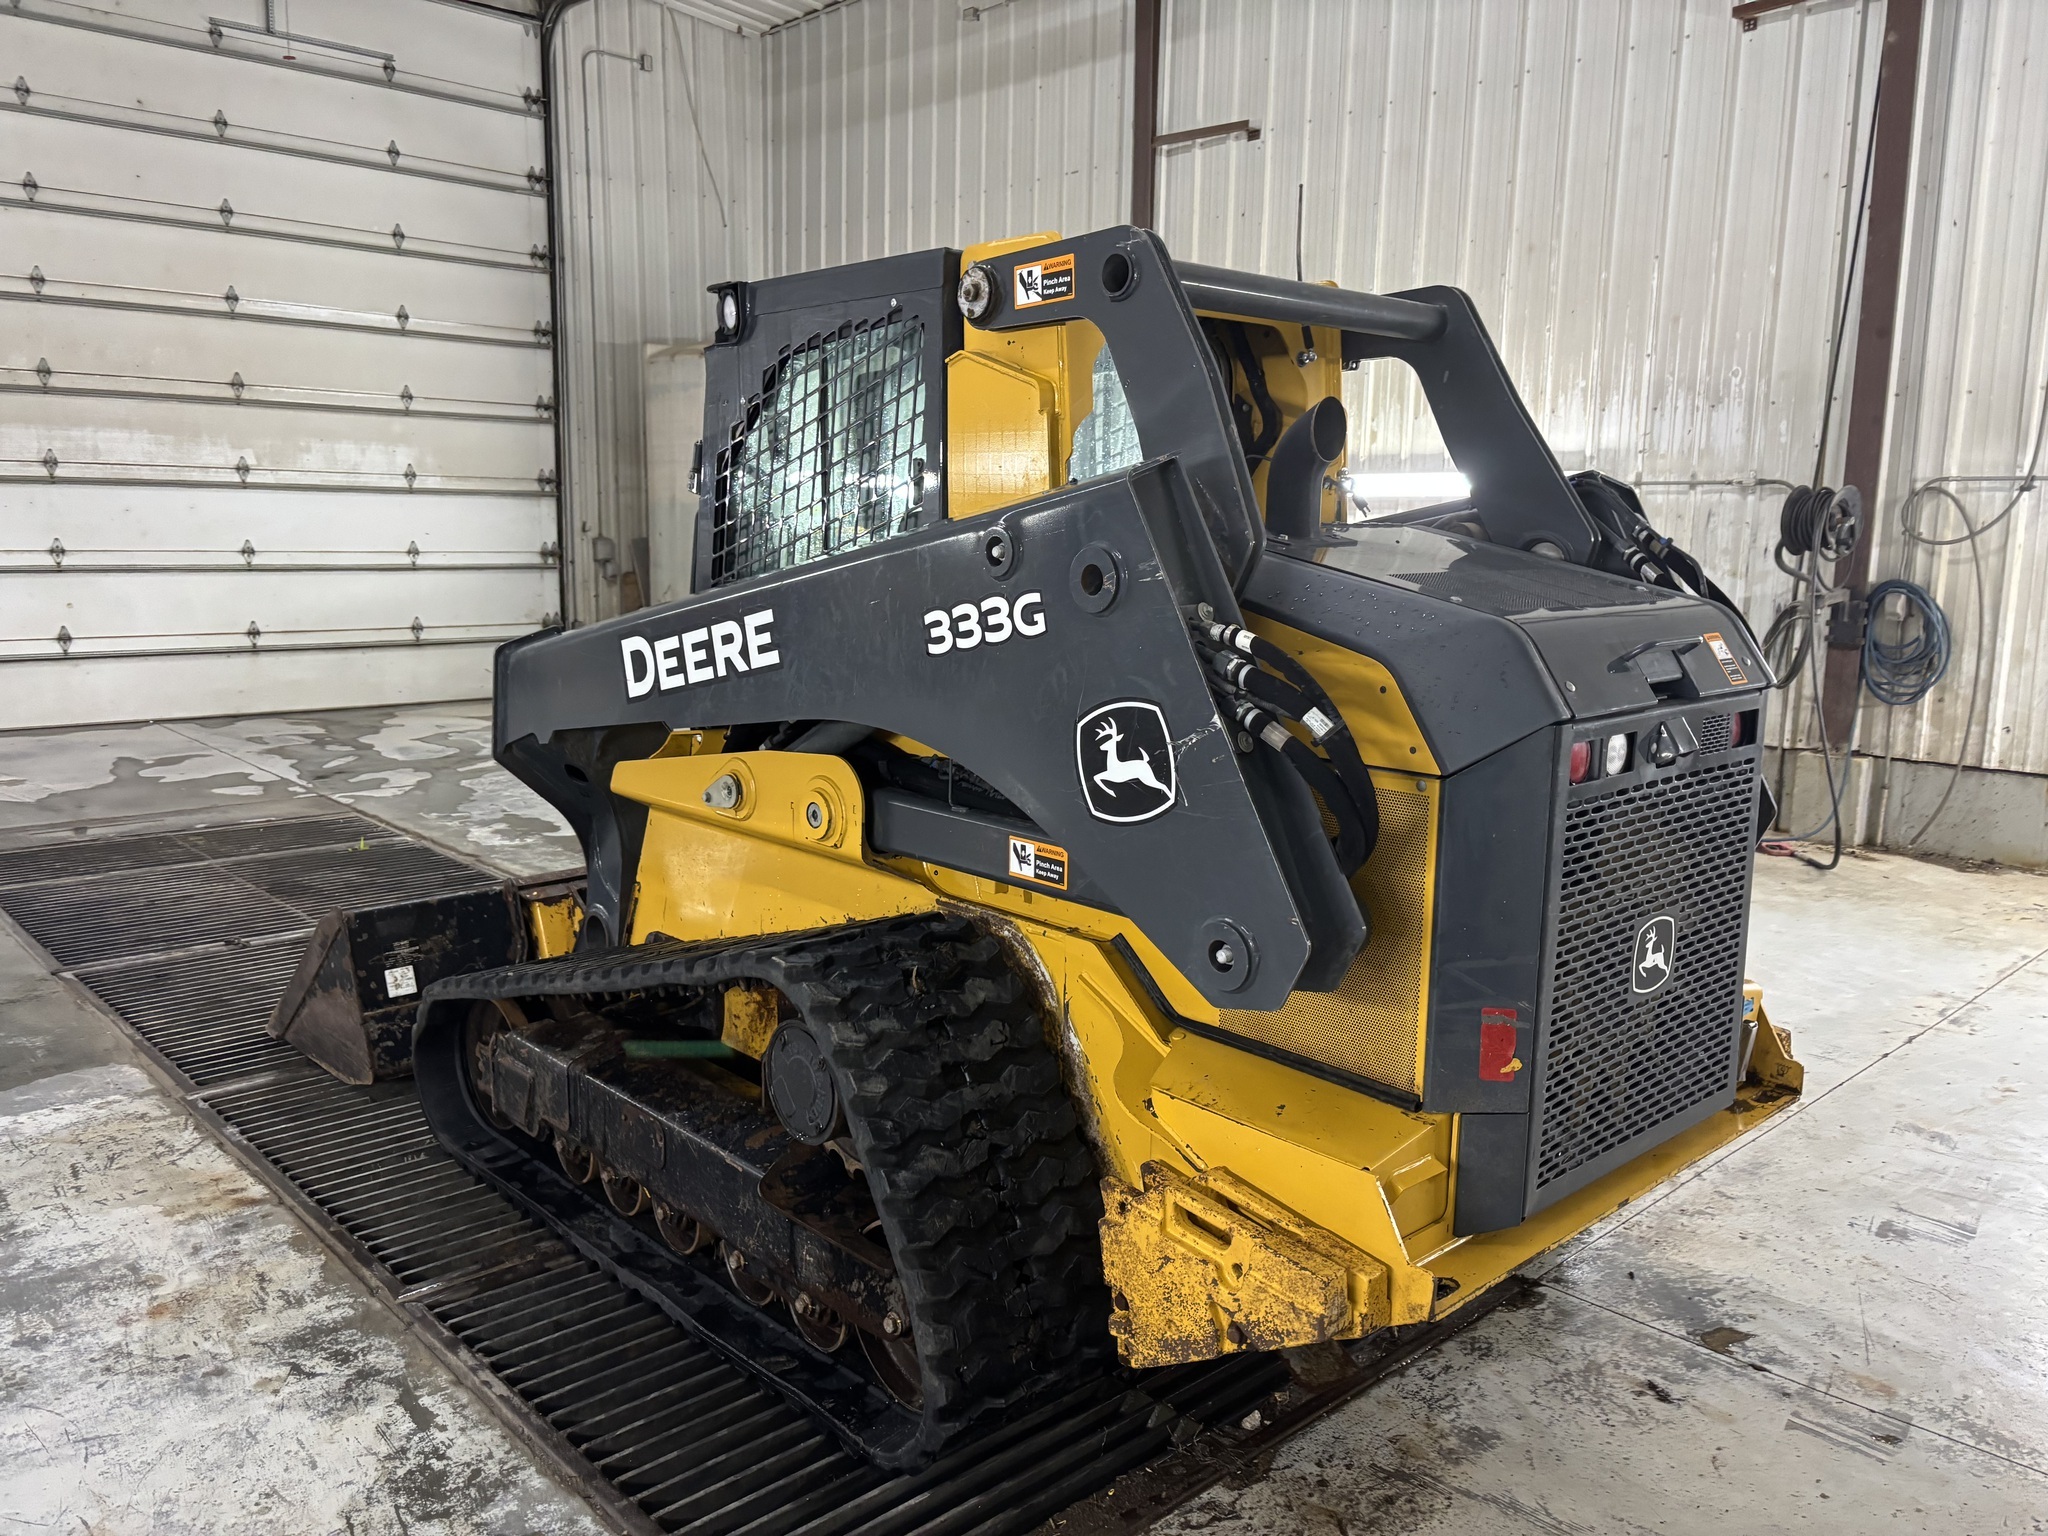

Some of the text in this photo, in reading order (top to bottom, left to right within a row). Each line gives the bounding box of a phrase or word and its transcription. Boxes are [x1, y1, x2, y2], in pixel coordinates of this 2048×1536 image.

[1048, 259, 1072, 269] WARNING
[1043, 275, 1071, 286] Pinch Area
[1055, 285, 1068, 293] Away
[923, 592, 1047, 655] 333G
[620, 608, 781, 699] DEERE
[1041, 847, 1065, 858] WARNING
[1036, 859, 1063, 872] Pinch Area
[1036, 868, 1060, 880] Keep Away
